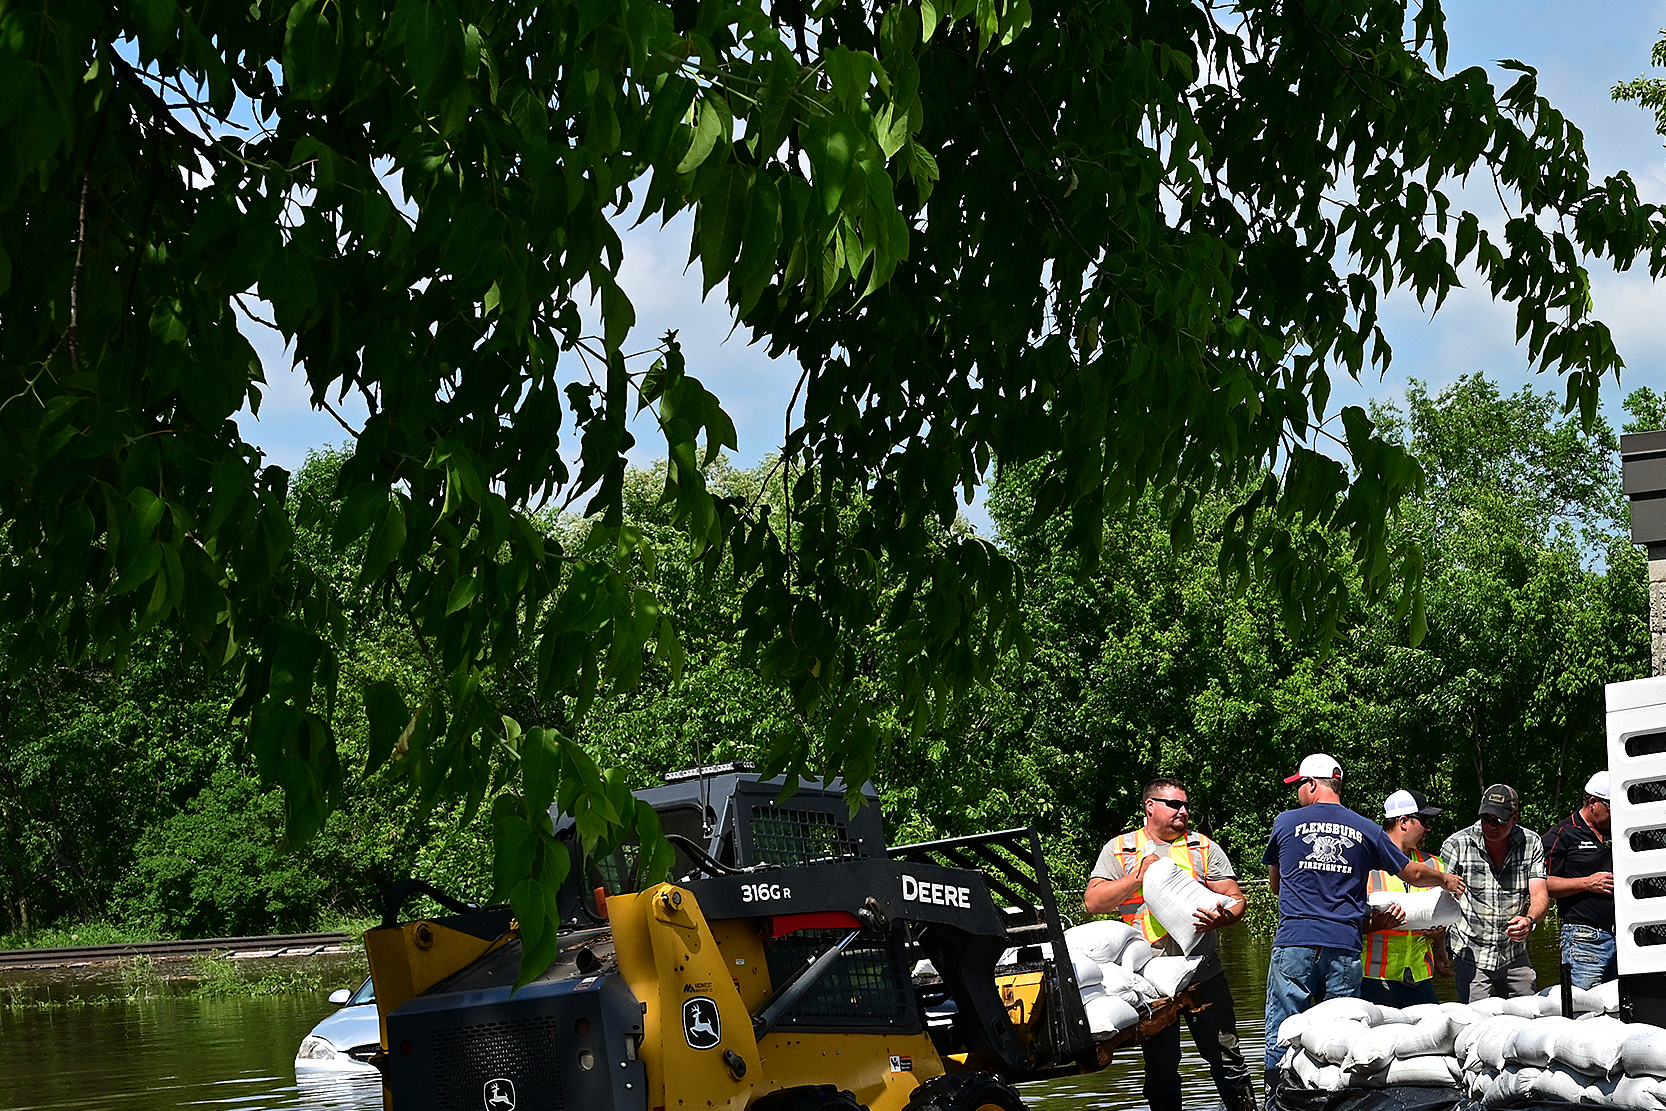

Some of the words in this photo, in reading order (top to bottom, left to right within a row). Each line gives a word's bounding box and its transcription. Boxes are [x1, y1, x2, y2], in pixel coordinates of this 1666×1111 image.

[1294, 822, 1363, 844] FLENSBURG
[1298, 860, 1353, 874] FIREFIGHTER
[901, 874, 971, 909] DEERE
